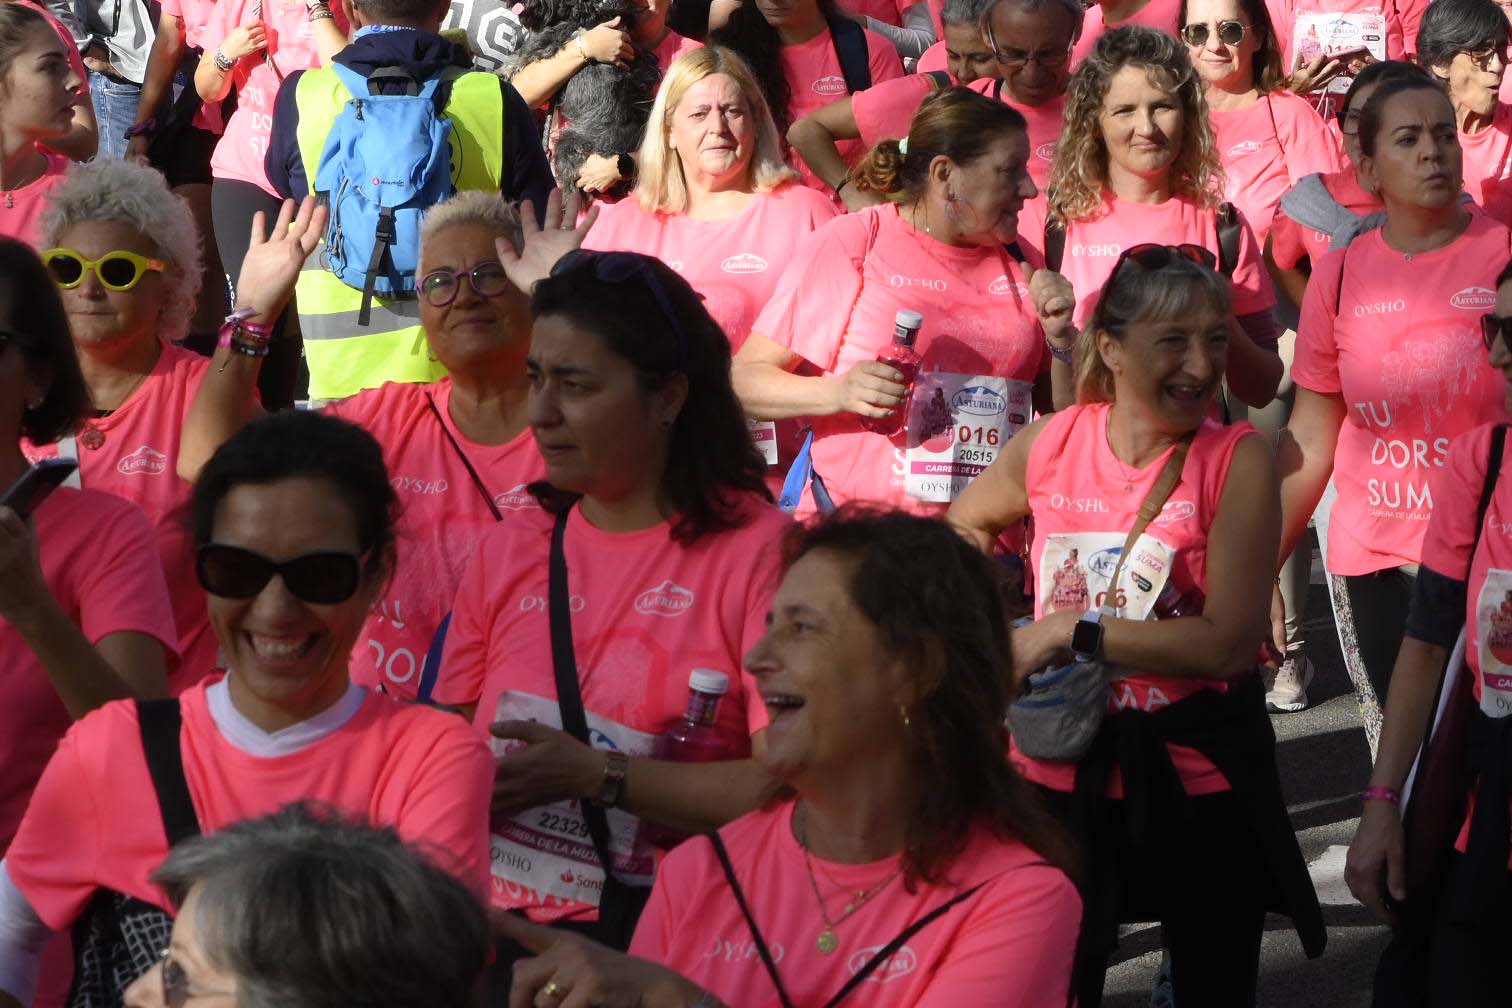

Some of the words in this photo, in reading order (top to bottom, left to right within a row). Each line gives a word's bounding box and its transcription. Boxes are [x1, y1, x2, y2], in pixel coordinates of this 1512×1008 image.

[1072, 244, 1121, 257] OYSHO
[1354, 299, 1406, 318] OYSHO
[957, 396, 1003, 410] ASTURIANA
[1355, 399, 1393, 429] TU
[958, 425, 999, 446] 016
[959, 449, 993, 463] 20515
[1371, 437, 1450, 470] DORS
[920, 481, 961, 493] OYSHO
[1367, 478, 1434, 510] SUM
[520, 595, 586, 613] OYO
[538, 811, 590, 838] 22329
[554, 841, 569, 854] LA
